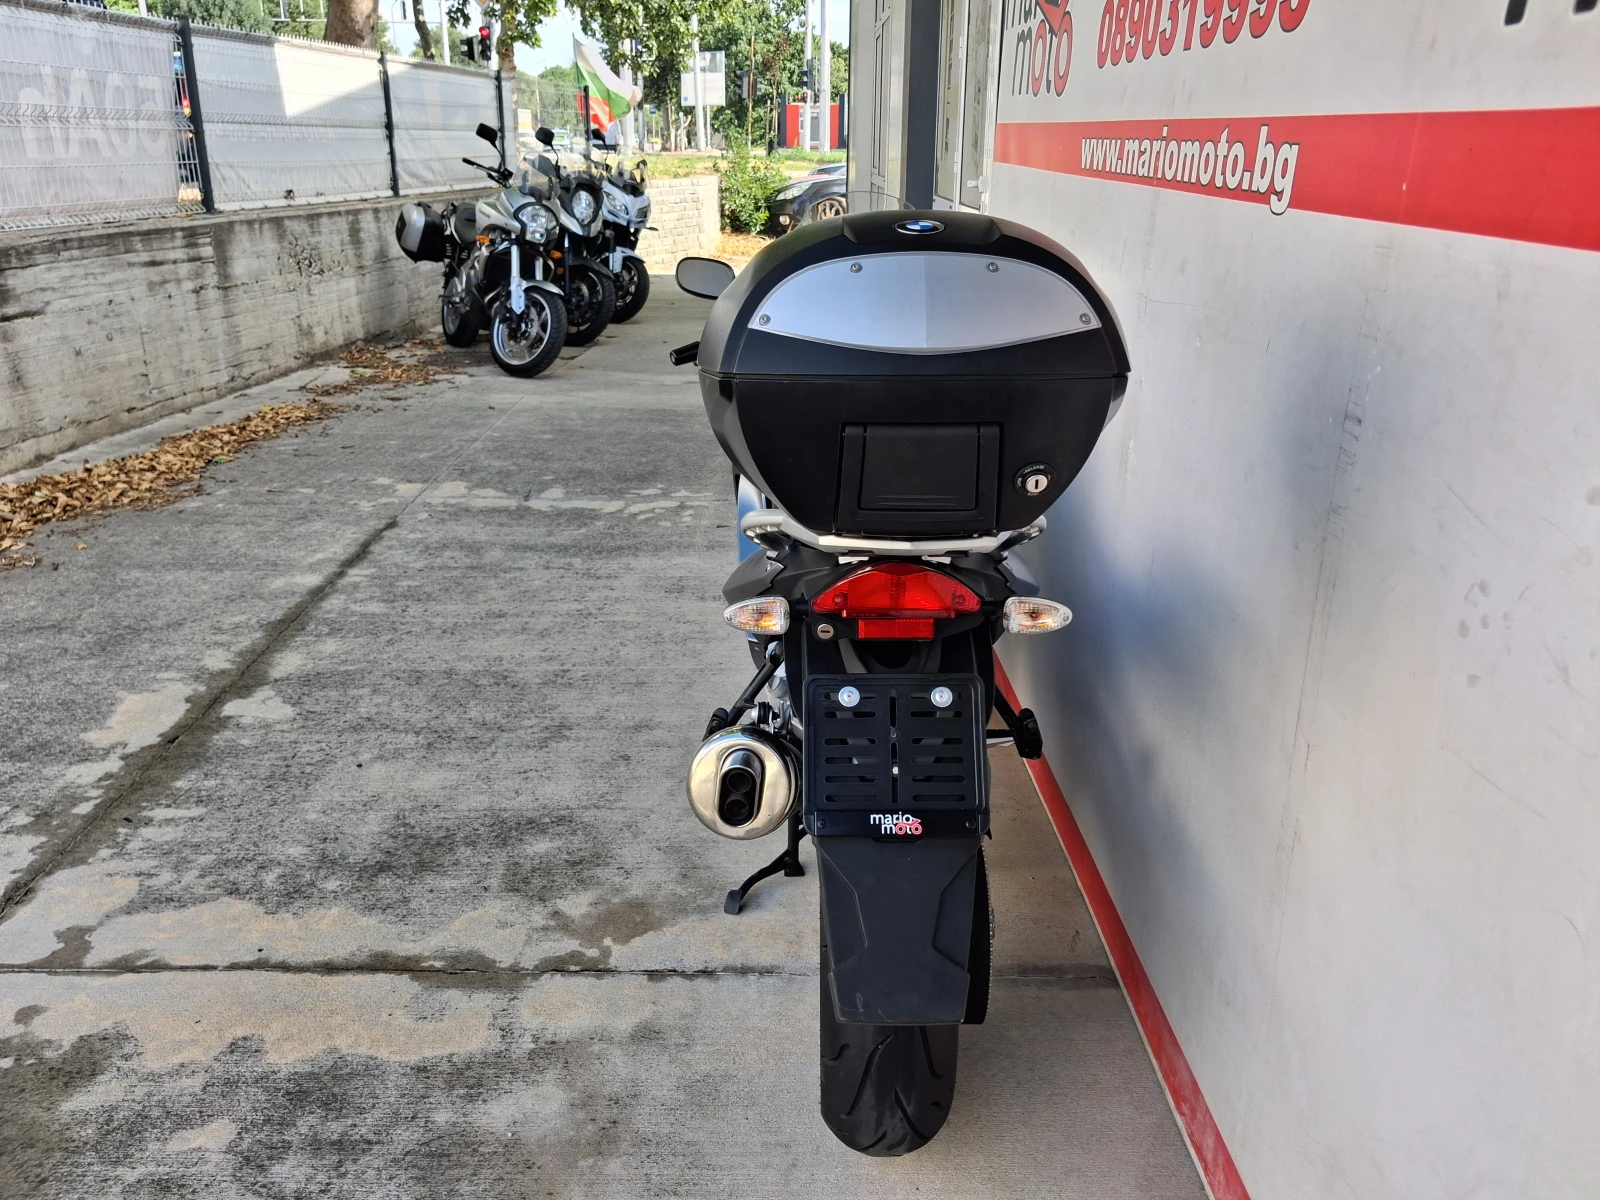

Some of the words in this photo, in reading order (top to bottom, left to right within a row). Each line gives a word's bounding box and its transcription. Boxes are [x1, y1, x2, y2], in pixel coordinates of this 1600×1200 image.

[1012, 10, 1073, 98] moto
[1081, 124, 1300, 215] www.mariomoto.bg
[870, 811, 912, 825] mario
[881, 824, 923, 835] moto
